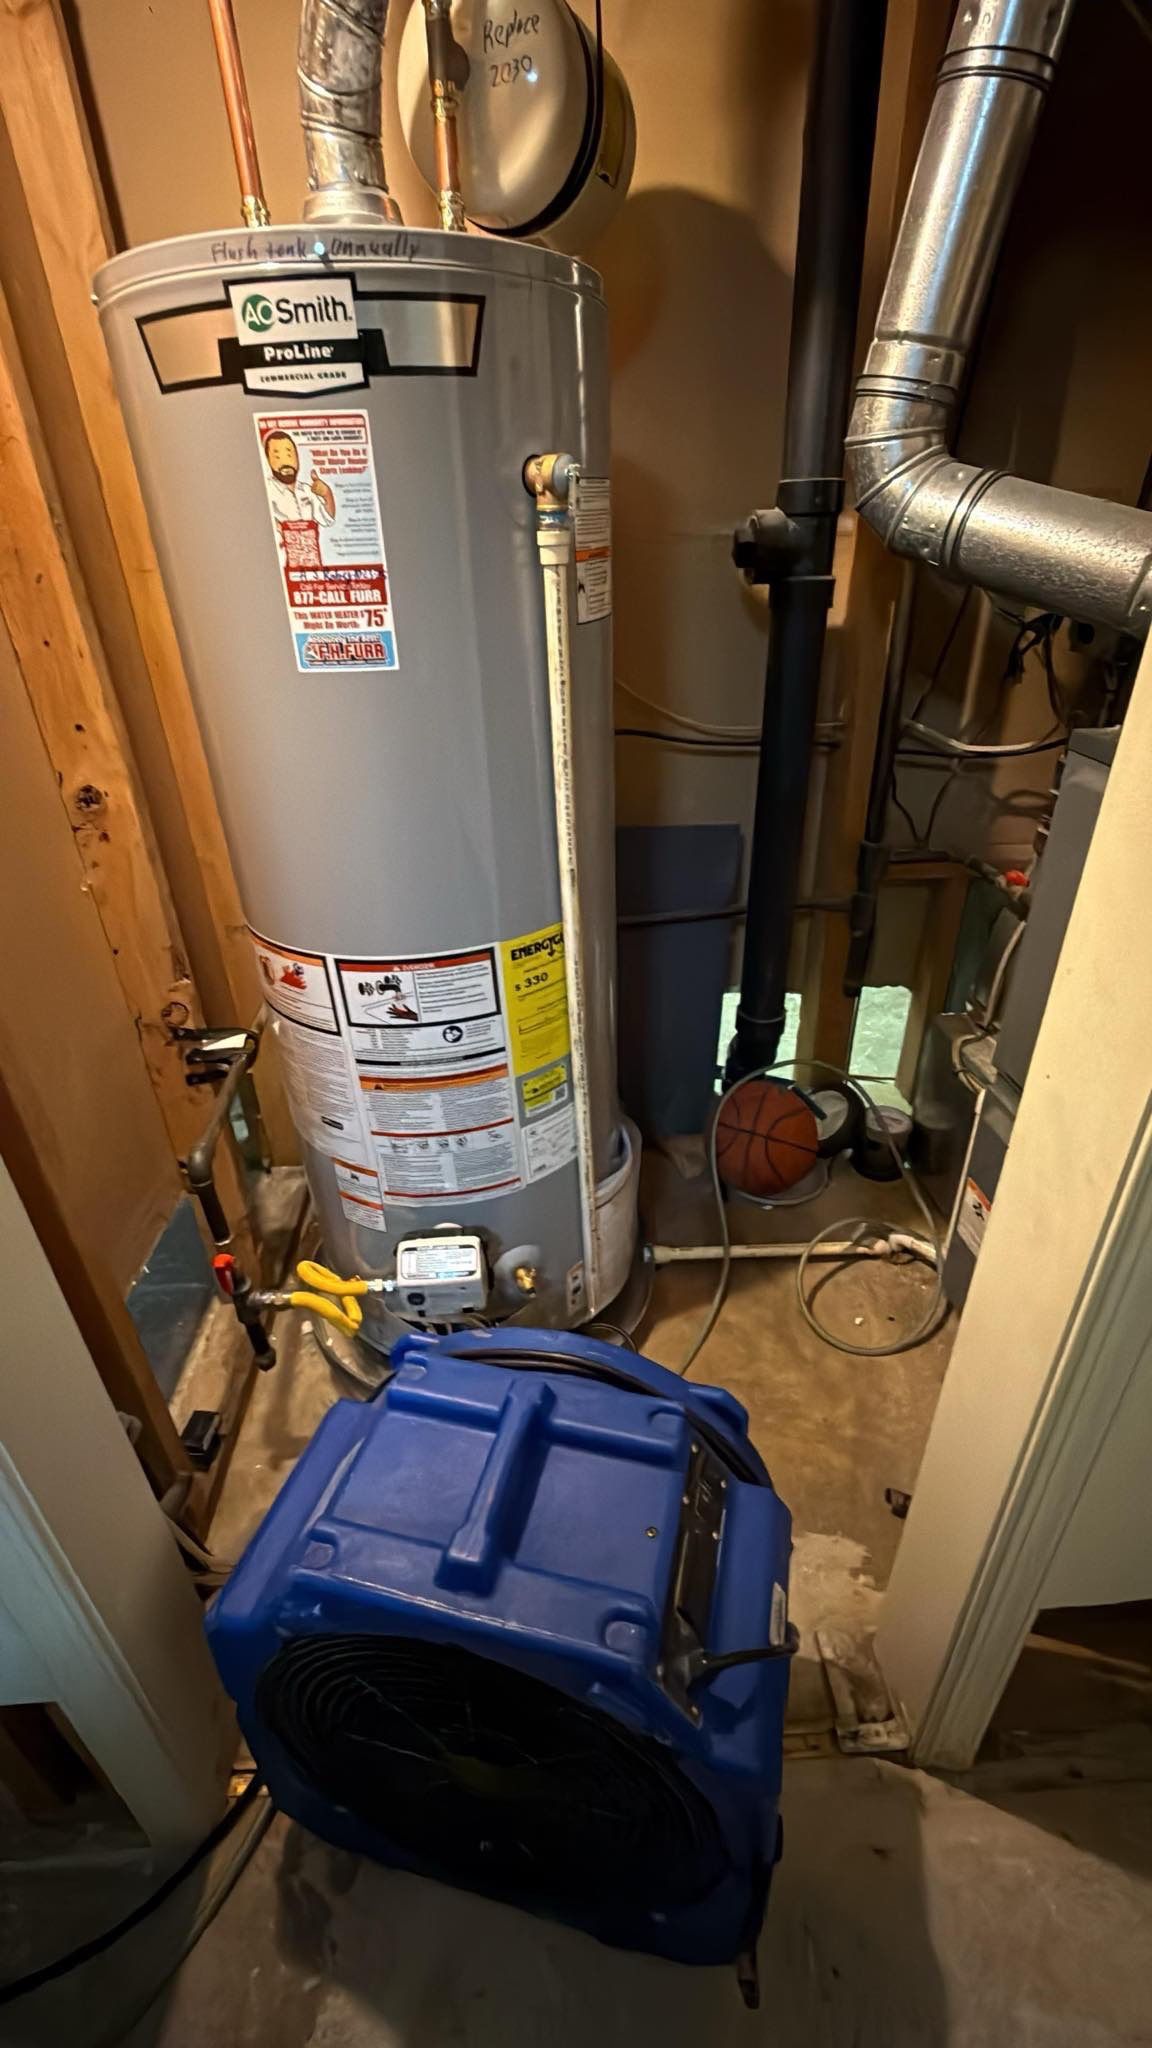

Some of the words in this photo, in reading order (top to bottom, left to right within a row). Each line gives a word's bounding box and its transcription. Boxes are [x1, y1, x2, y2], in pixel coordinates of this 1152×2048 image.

[483, 10, 540, 53] Replace
[489, 54, 533, 88] 2030
[211, 235, 257, 263] Flush
[275, 295, 349, 324] Smith
[263, 343, 332, 361] ProLine
[260, 372, 315, 383] COMMERCIAL
[317, 370, 347, 380] GRADE
[350, 589, 382, 603] FURR
